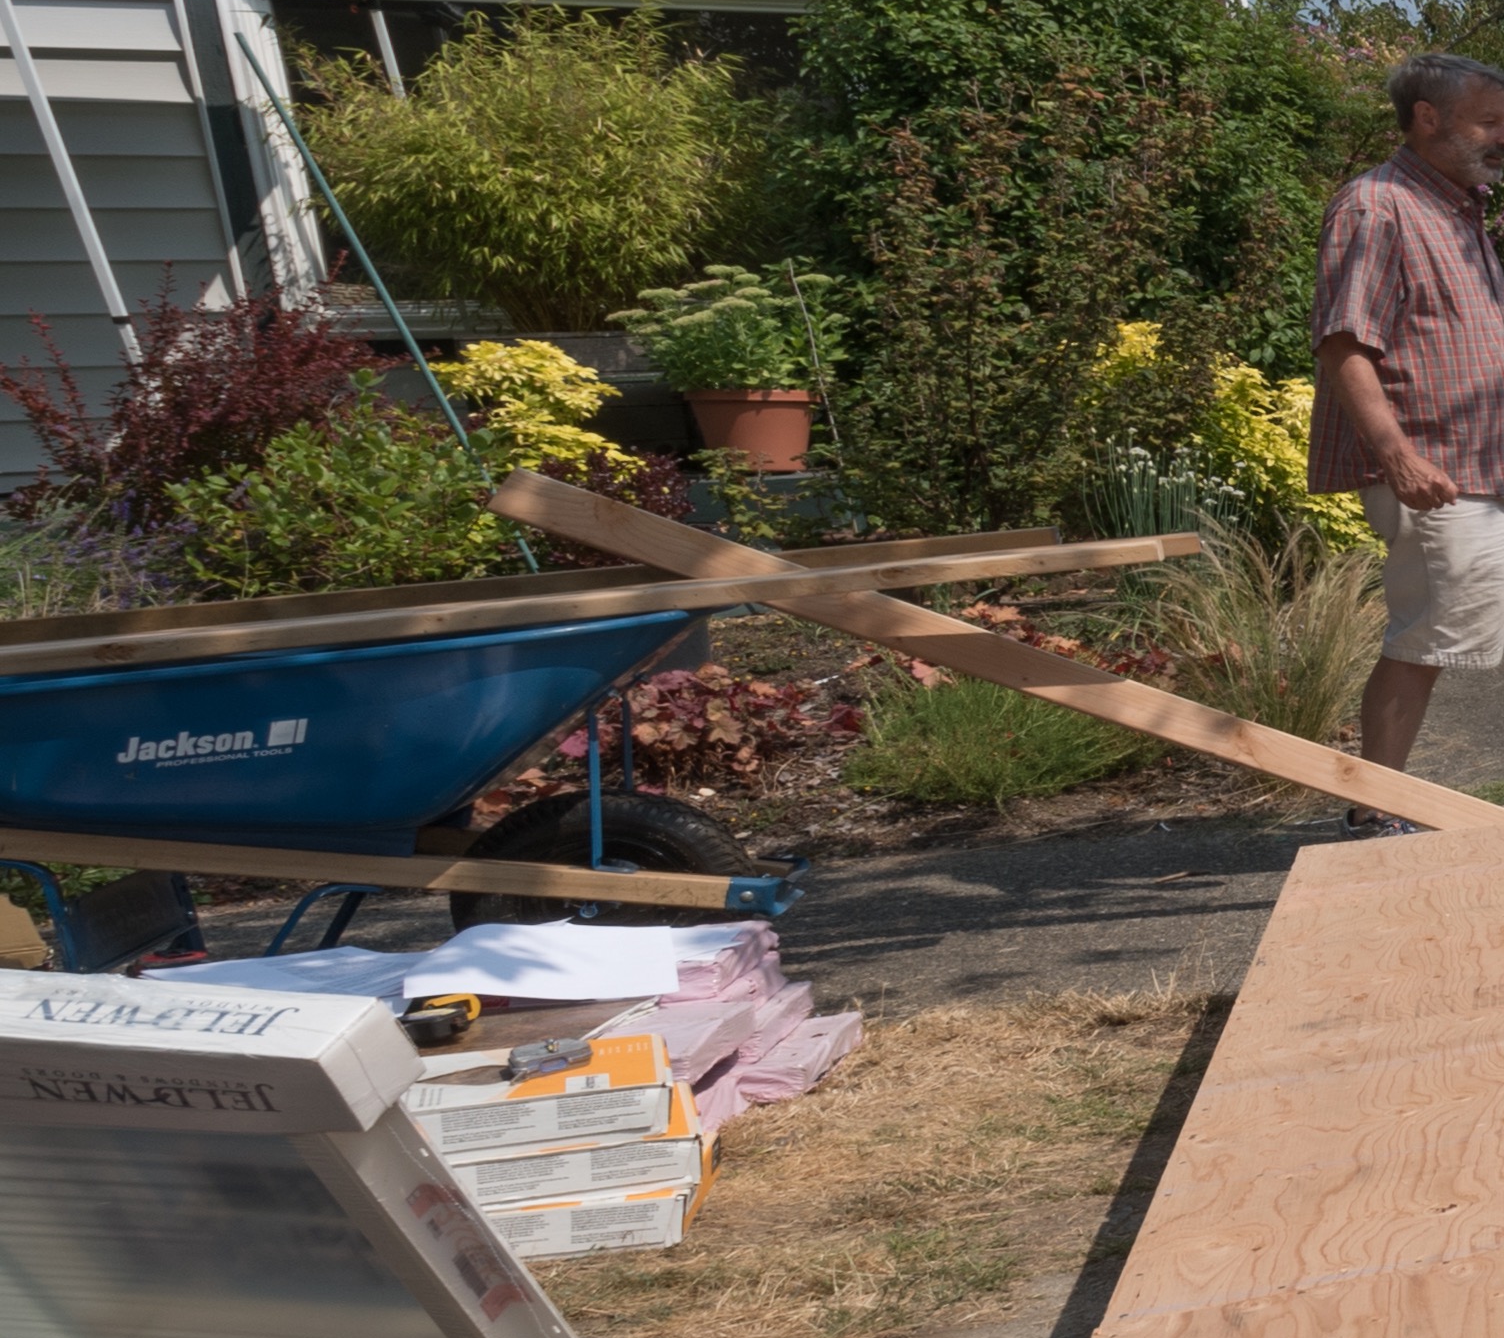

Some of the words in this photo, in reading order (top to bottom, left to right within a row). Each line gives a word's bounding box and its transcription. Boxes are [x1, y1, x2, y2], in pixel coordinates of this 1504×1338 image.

[117, 730, 254, 763] Jackson
[156, 752, 250, 768] PROFESSIONAL
[252, 747, 293, 757] TOOLS
[21, 1067, 101, 1080] DOORS
[139, 1074, 249, 1090] WINDOWS
